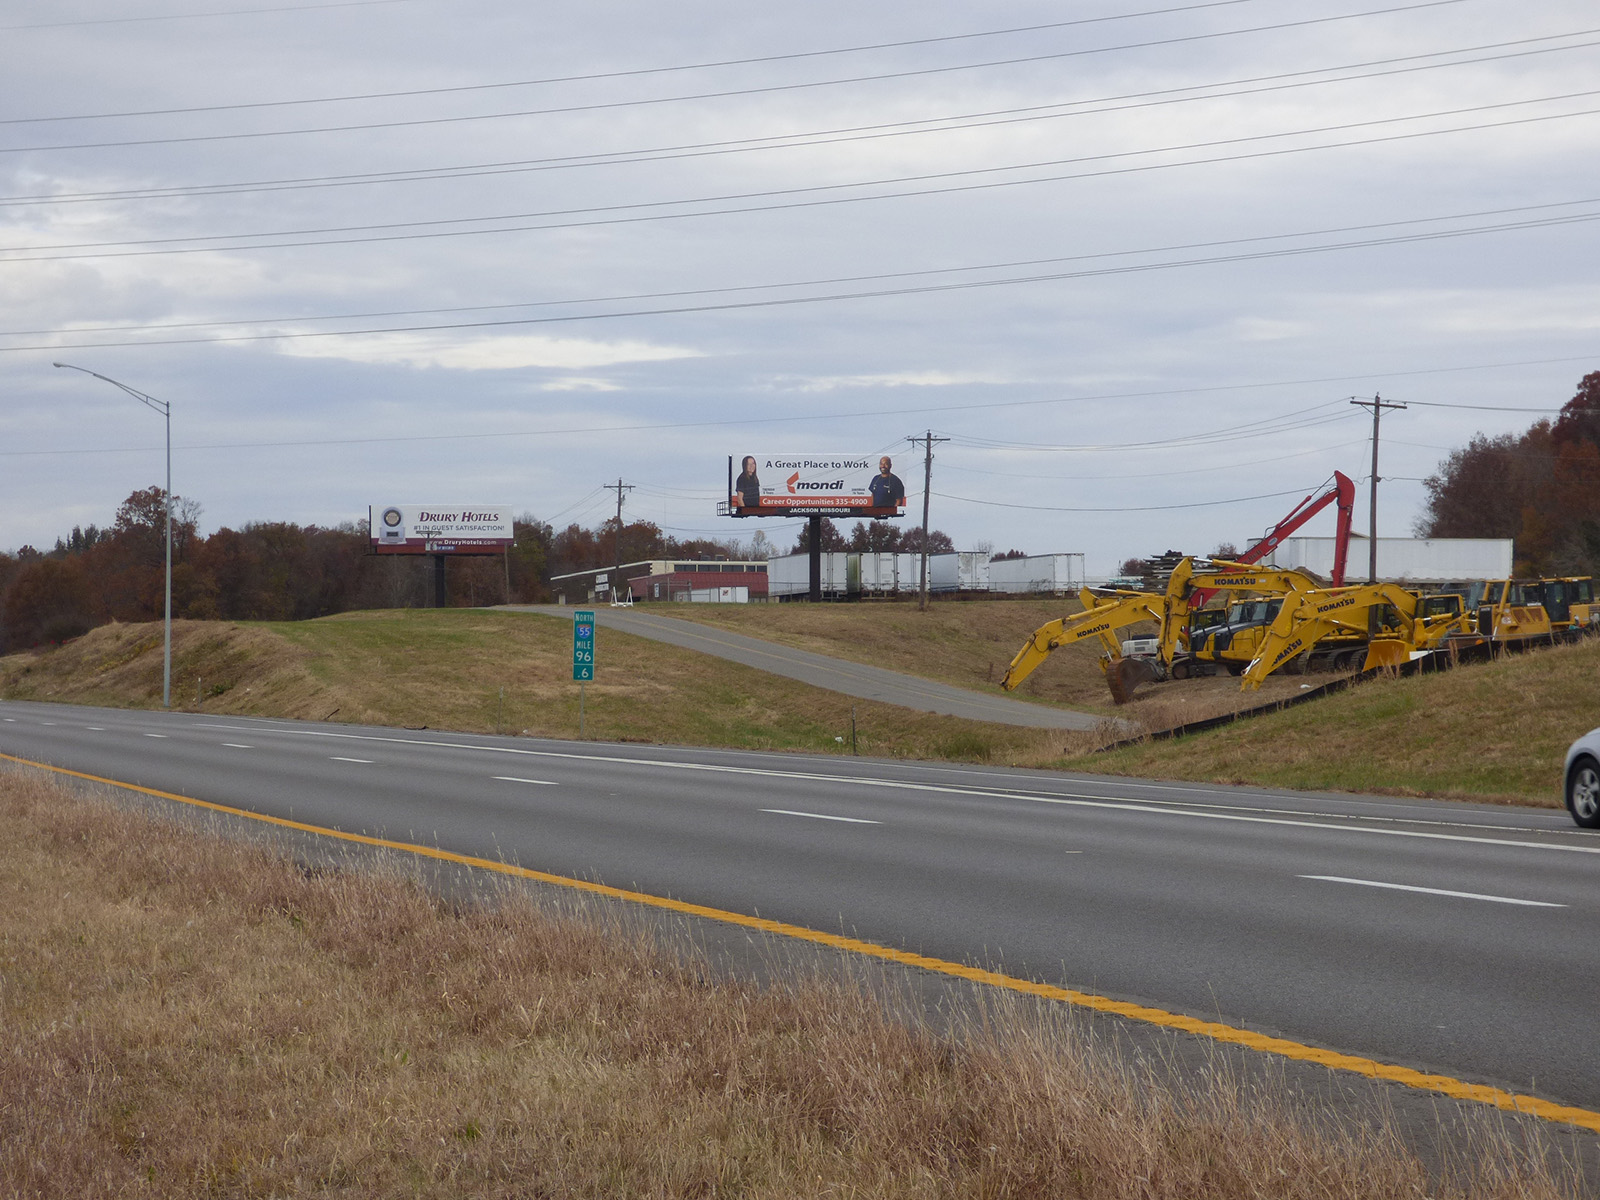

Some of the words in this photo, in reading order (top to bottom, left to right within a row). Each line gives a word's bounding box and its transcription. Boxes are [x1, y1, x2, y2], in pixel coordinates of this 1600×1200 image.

[766, 460, 772, 468] A
[775, 460, 802, 468] Great
[804, 460, 829, 468] Place
[843, 460, 869, 469] Work
[796, 480, 844, 490] mondi
[786, 498, 834, 506] Opportunities
[835, 498, 868, 506] 335-4900
[1214, 576, 1256, 586] KOMATSU
[1317, 597, 1356, 613] KOMATSU
[579, 627, 590, 636] 55
[1076, 622, 1110, 638] KOMATSU
[576, 640, 591, 650] MILE
[576, 651, 591, 662] 96
